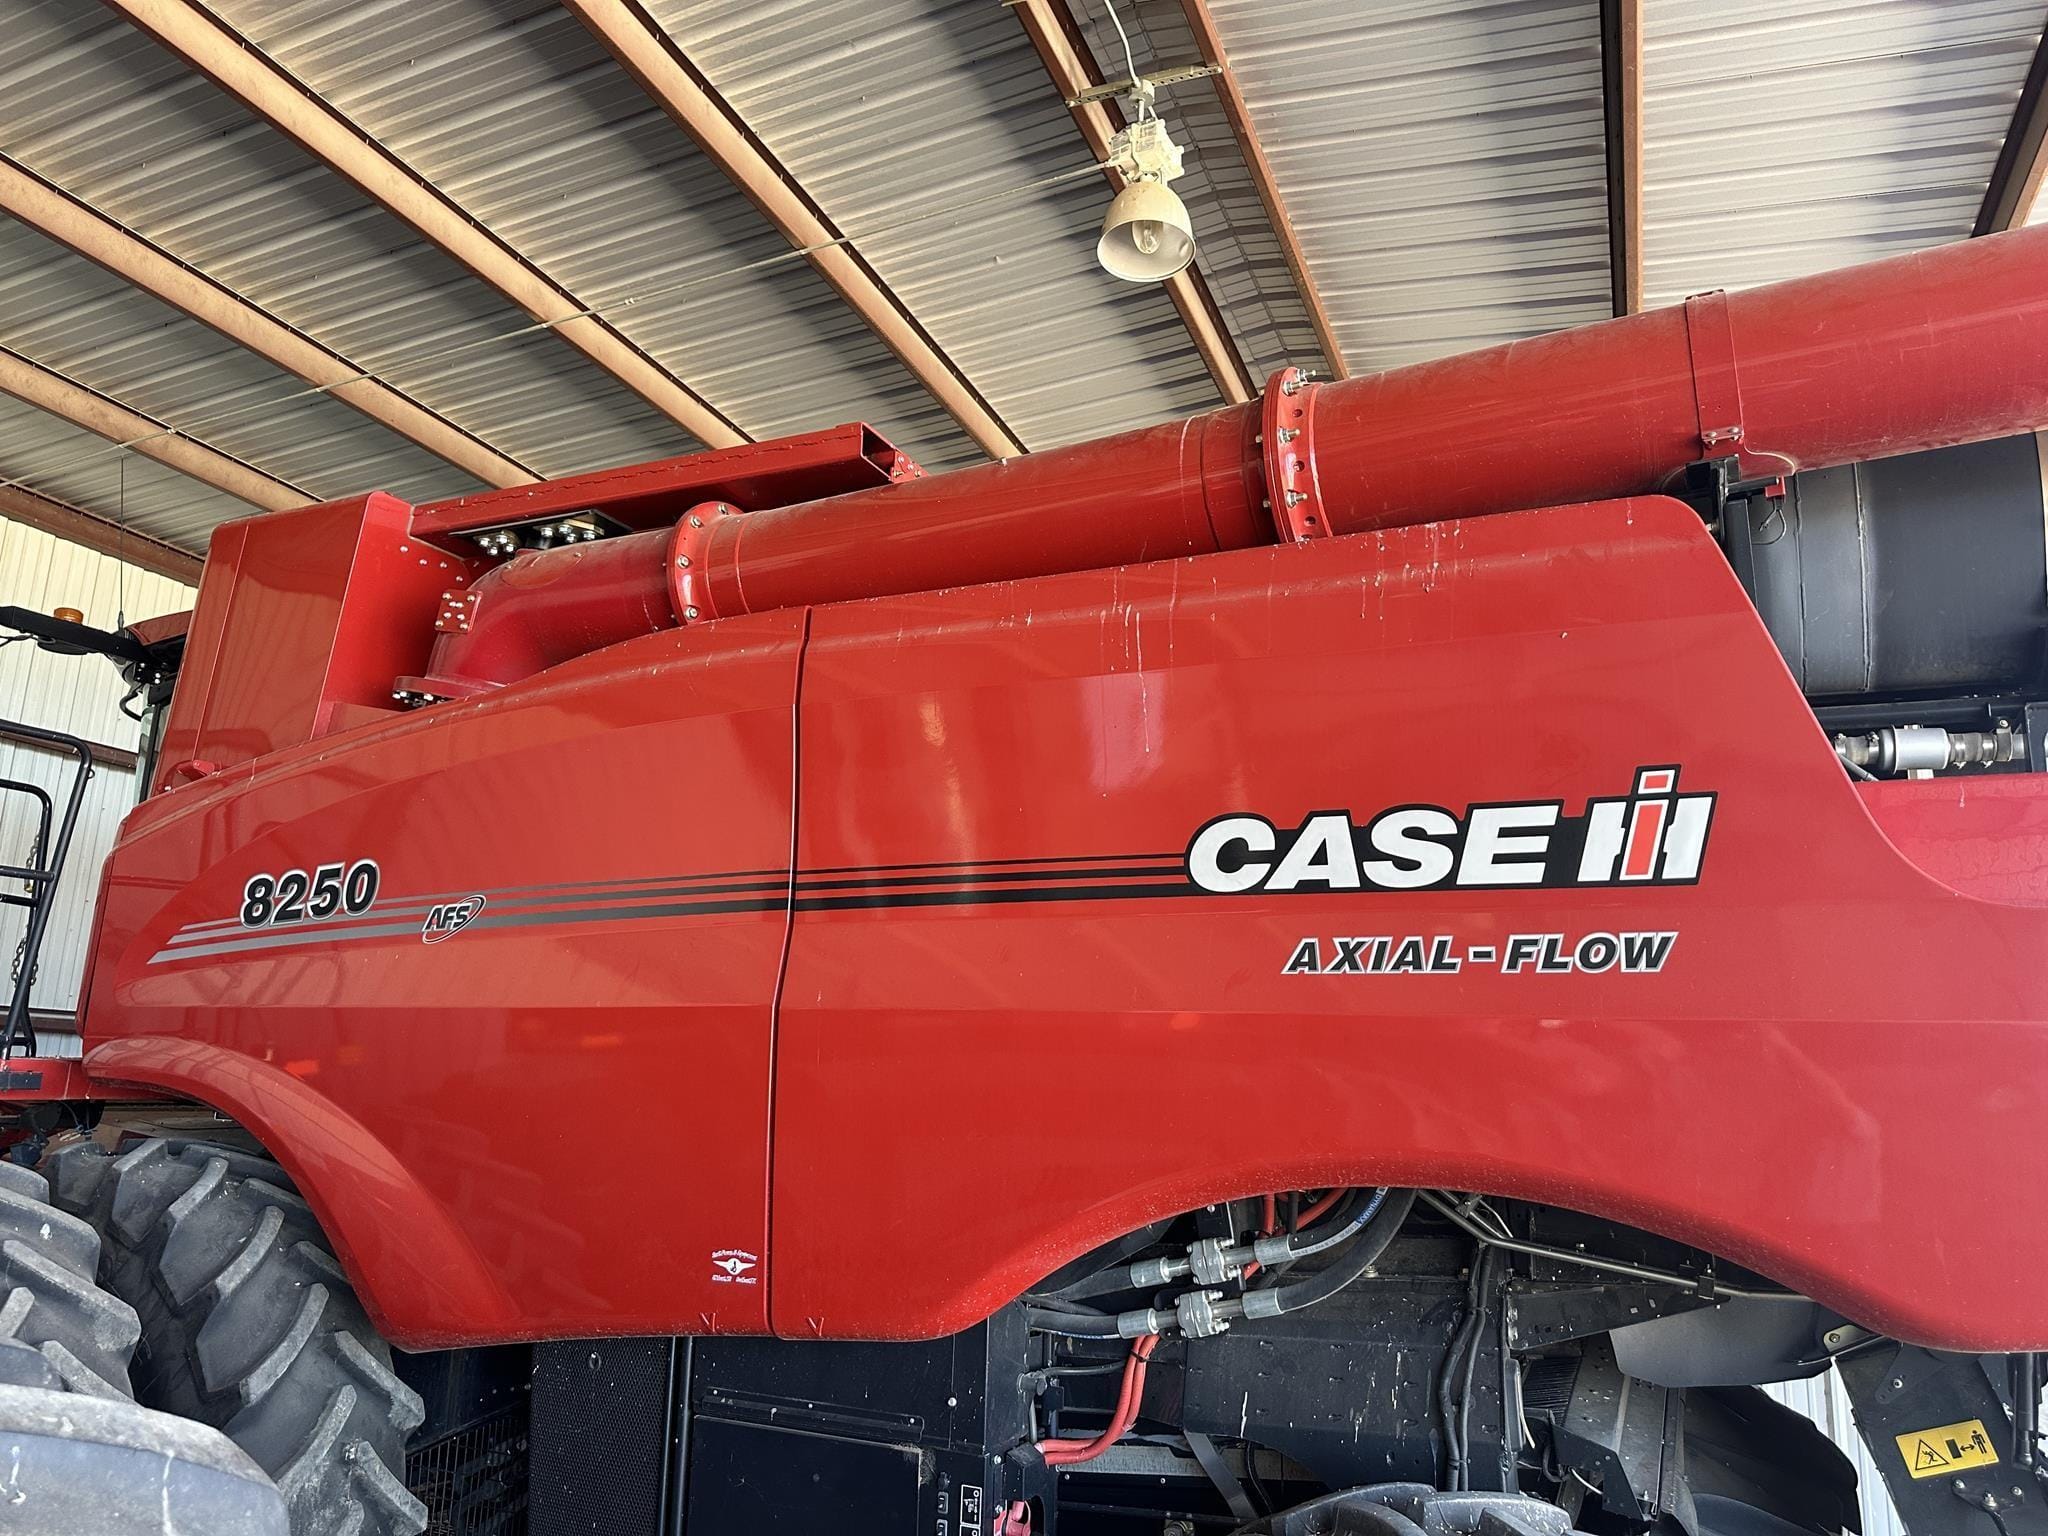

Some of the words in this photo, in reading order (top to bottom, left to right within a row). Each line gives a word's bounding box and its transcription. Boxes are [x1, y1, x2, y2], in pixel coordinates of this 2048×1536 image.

[1188, 804, 1559, 894] CASE
[240, 858, 381, 930] 8250
[422, 902, 474, 932] AFS
